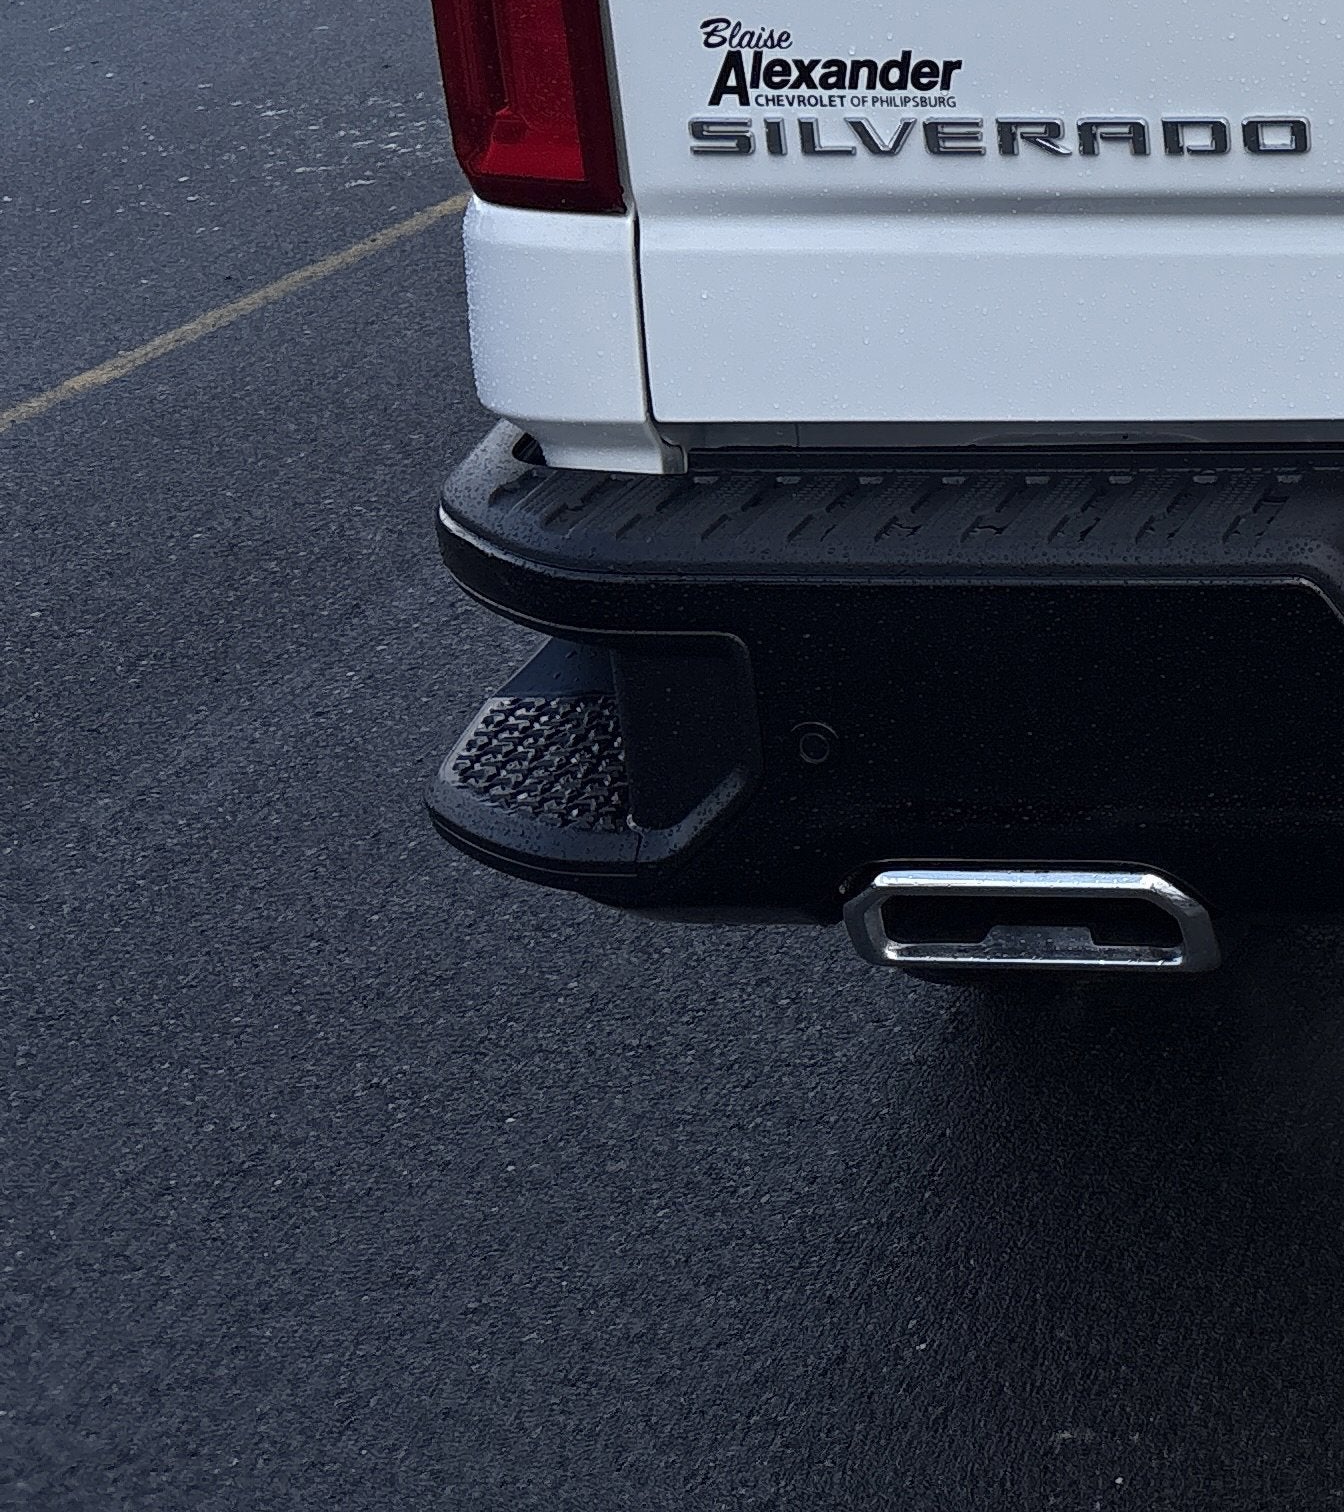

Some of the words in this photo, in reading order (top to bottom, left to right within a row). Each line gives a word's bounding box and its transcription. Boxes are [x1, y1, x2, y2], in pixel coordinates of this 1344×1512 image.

[700, 17, 793, 50] Blaise
[707, 49, 963, 107] Alexander
[754, 93, 846, 108] CHEVROLET
[850, 94, 869, 108] OF
[871, 94, 957, 109] PHILIPSBURG
[688, 116, 1312, 157] SILVERADO
